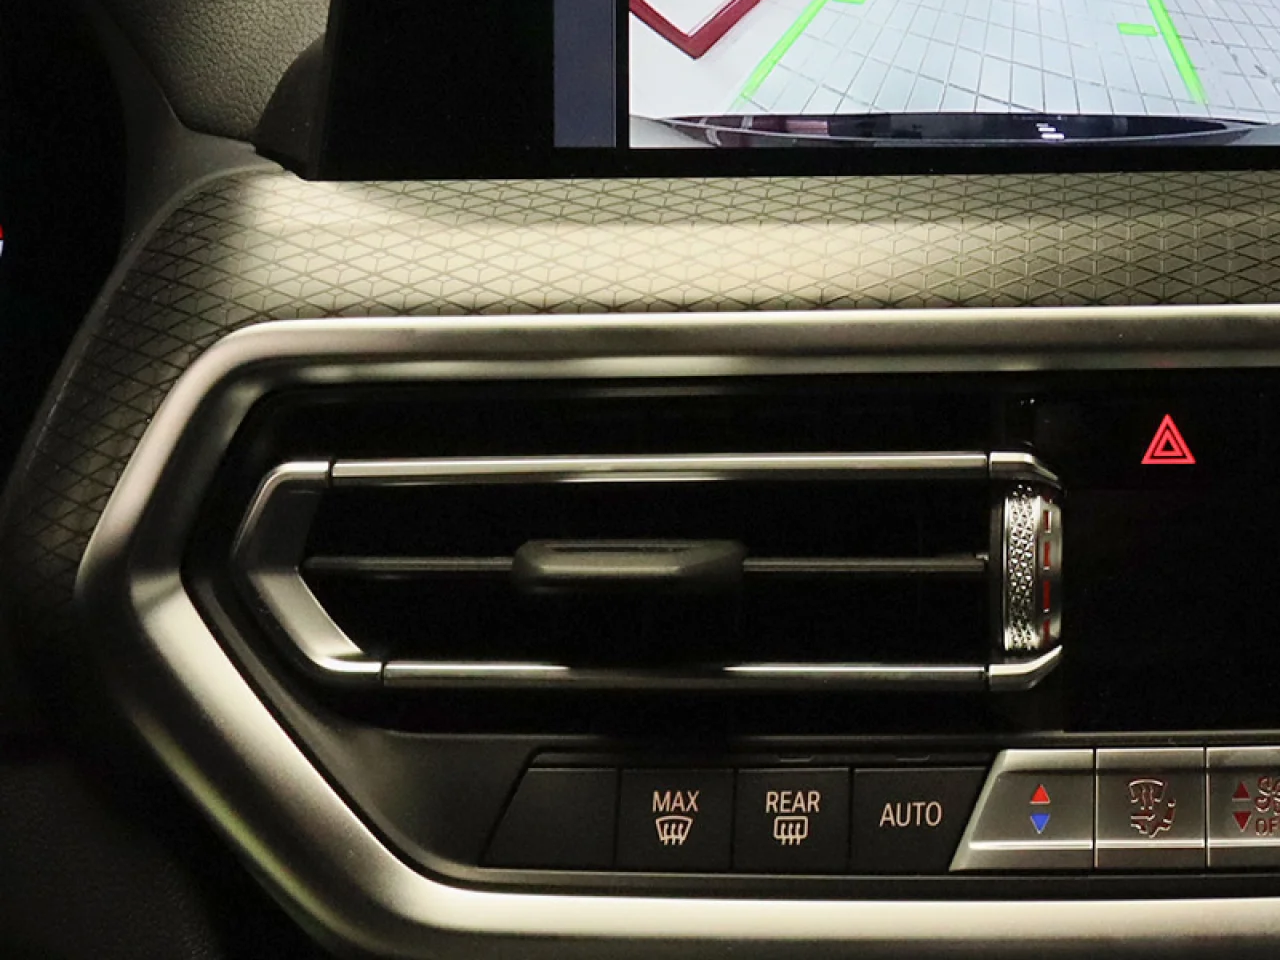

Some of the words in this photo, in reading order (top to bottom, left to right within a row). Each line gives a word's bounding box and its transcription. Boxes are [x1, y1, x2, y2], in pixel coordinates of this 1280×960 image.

[652, 790, 700, 813] MAX
[765, 791, 821, 814] REAR
[879, 801, 943, 828] AUTO
